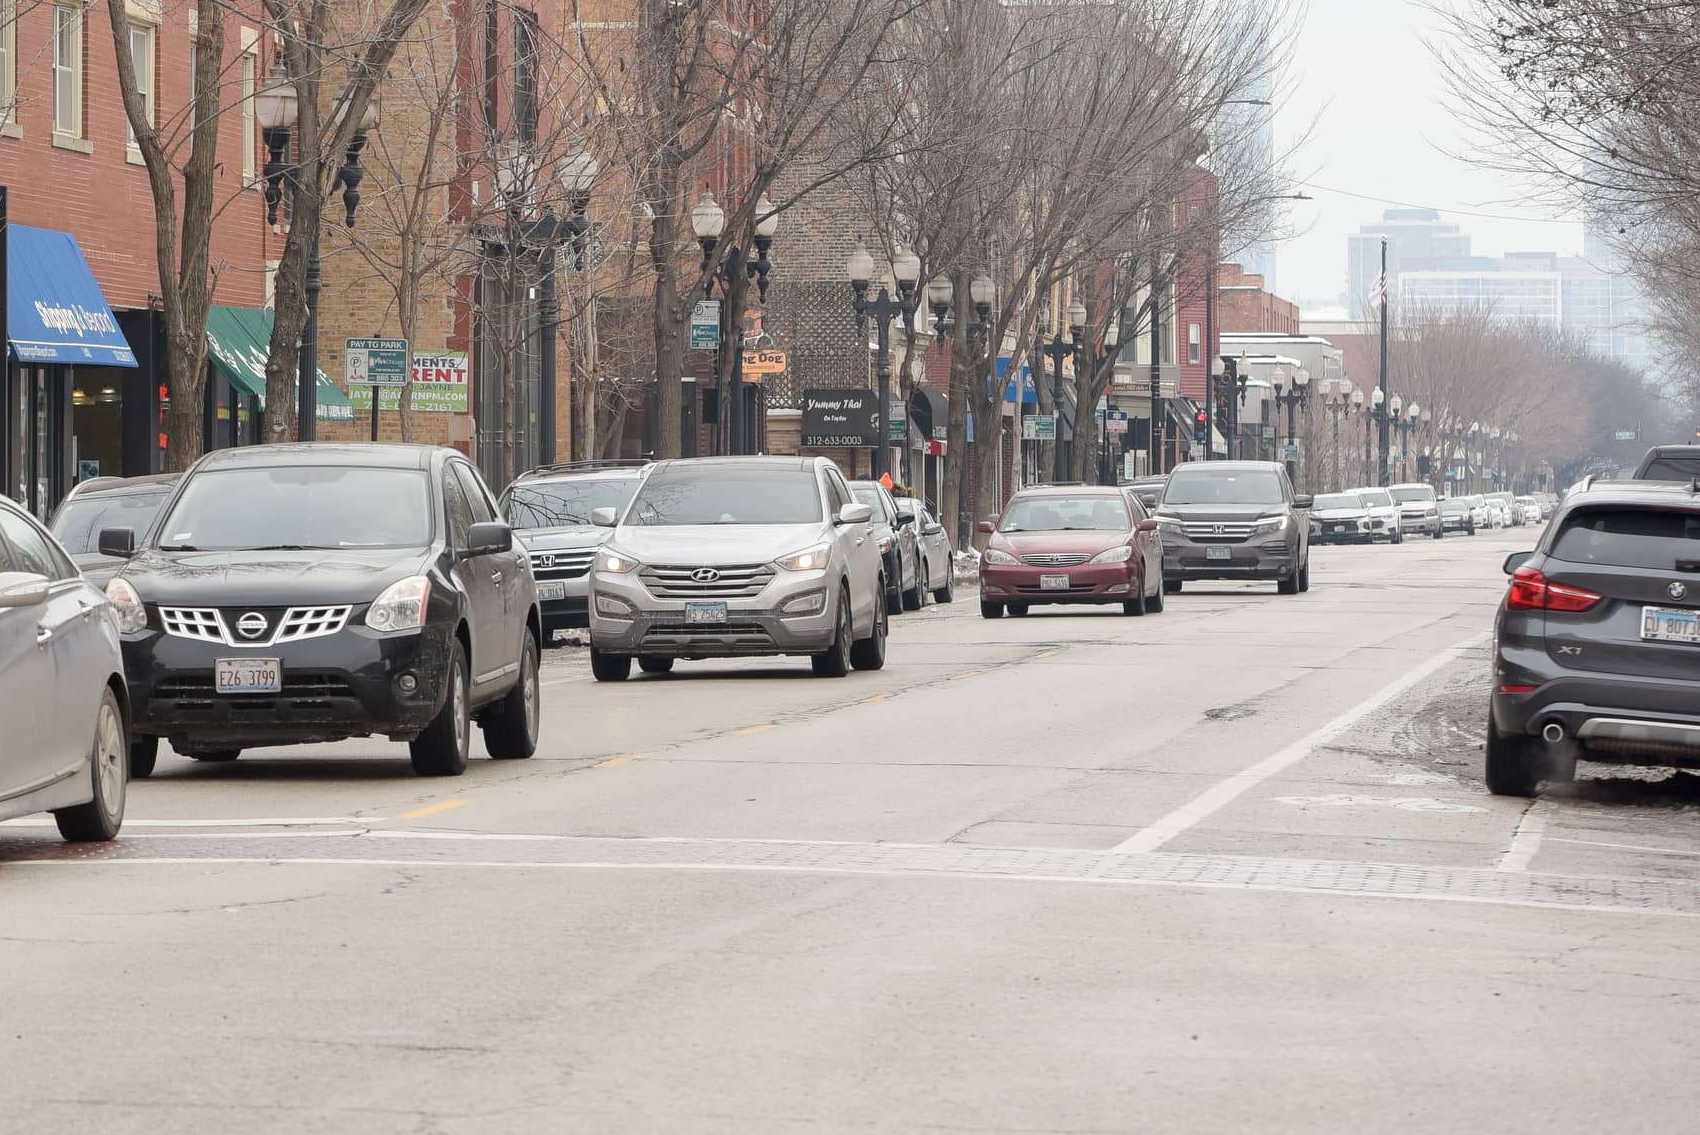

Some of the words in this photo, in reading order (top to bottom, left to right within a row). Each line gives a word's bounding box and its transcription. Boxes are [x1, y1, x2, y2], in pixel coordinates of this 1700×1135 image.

[350, 340, 367, 349] PAY
[368, 341, 379, 349] TO
[381, 341, 403, 349] PARK
[759, 353, 783, 364] Dog
[412, 368, 466, 383] RENT
[807, 399, 842, 411] Yummy
[843, 399, 862, 409] Thai
[807, 436, 862, 445] 312-633-0003
[1557, 645, 1582, 655] X1
[248, 669, 276, 687] 3799
